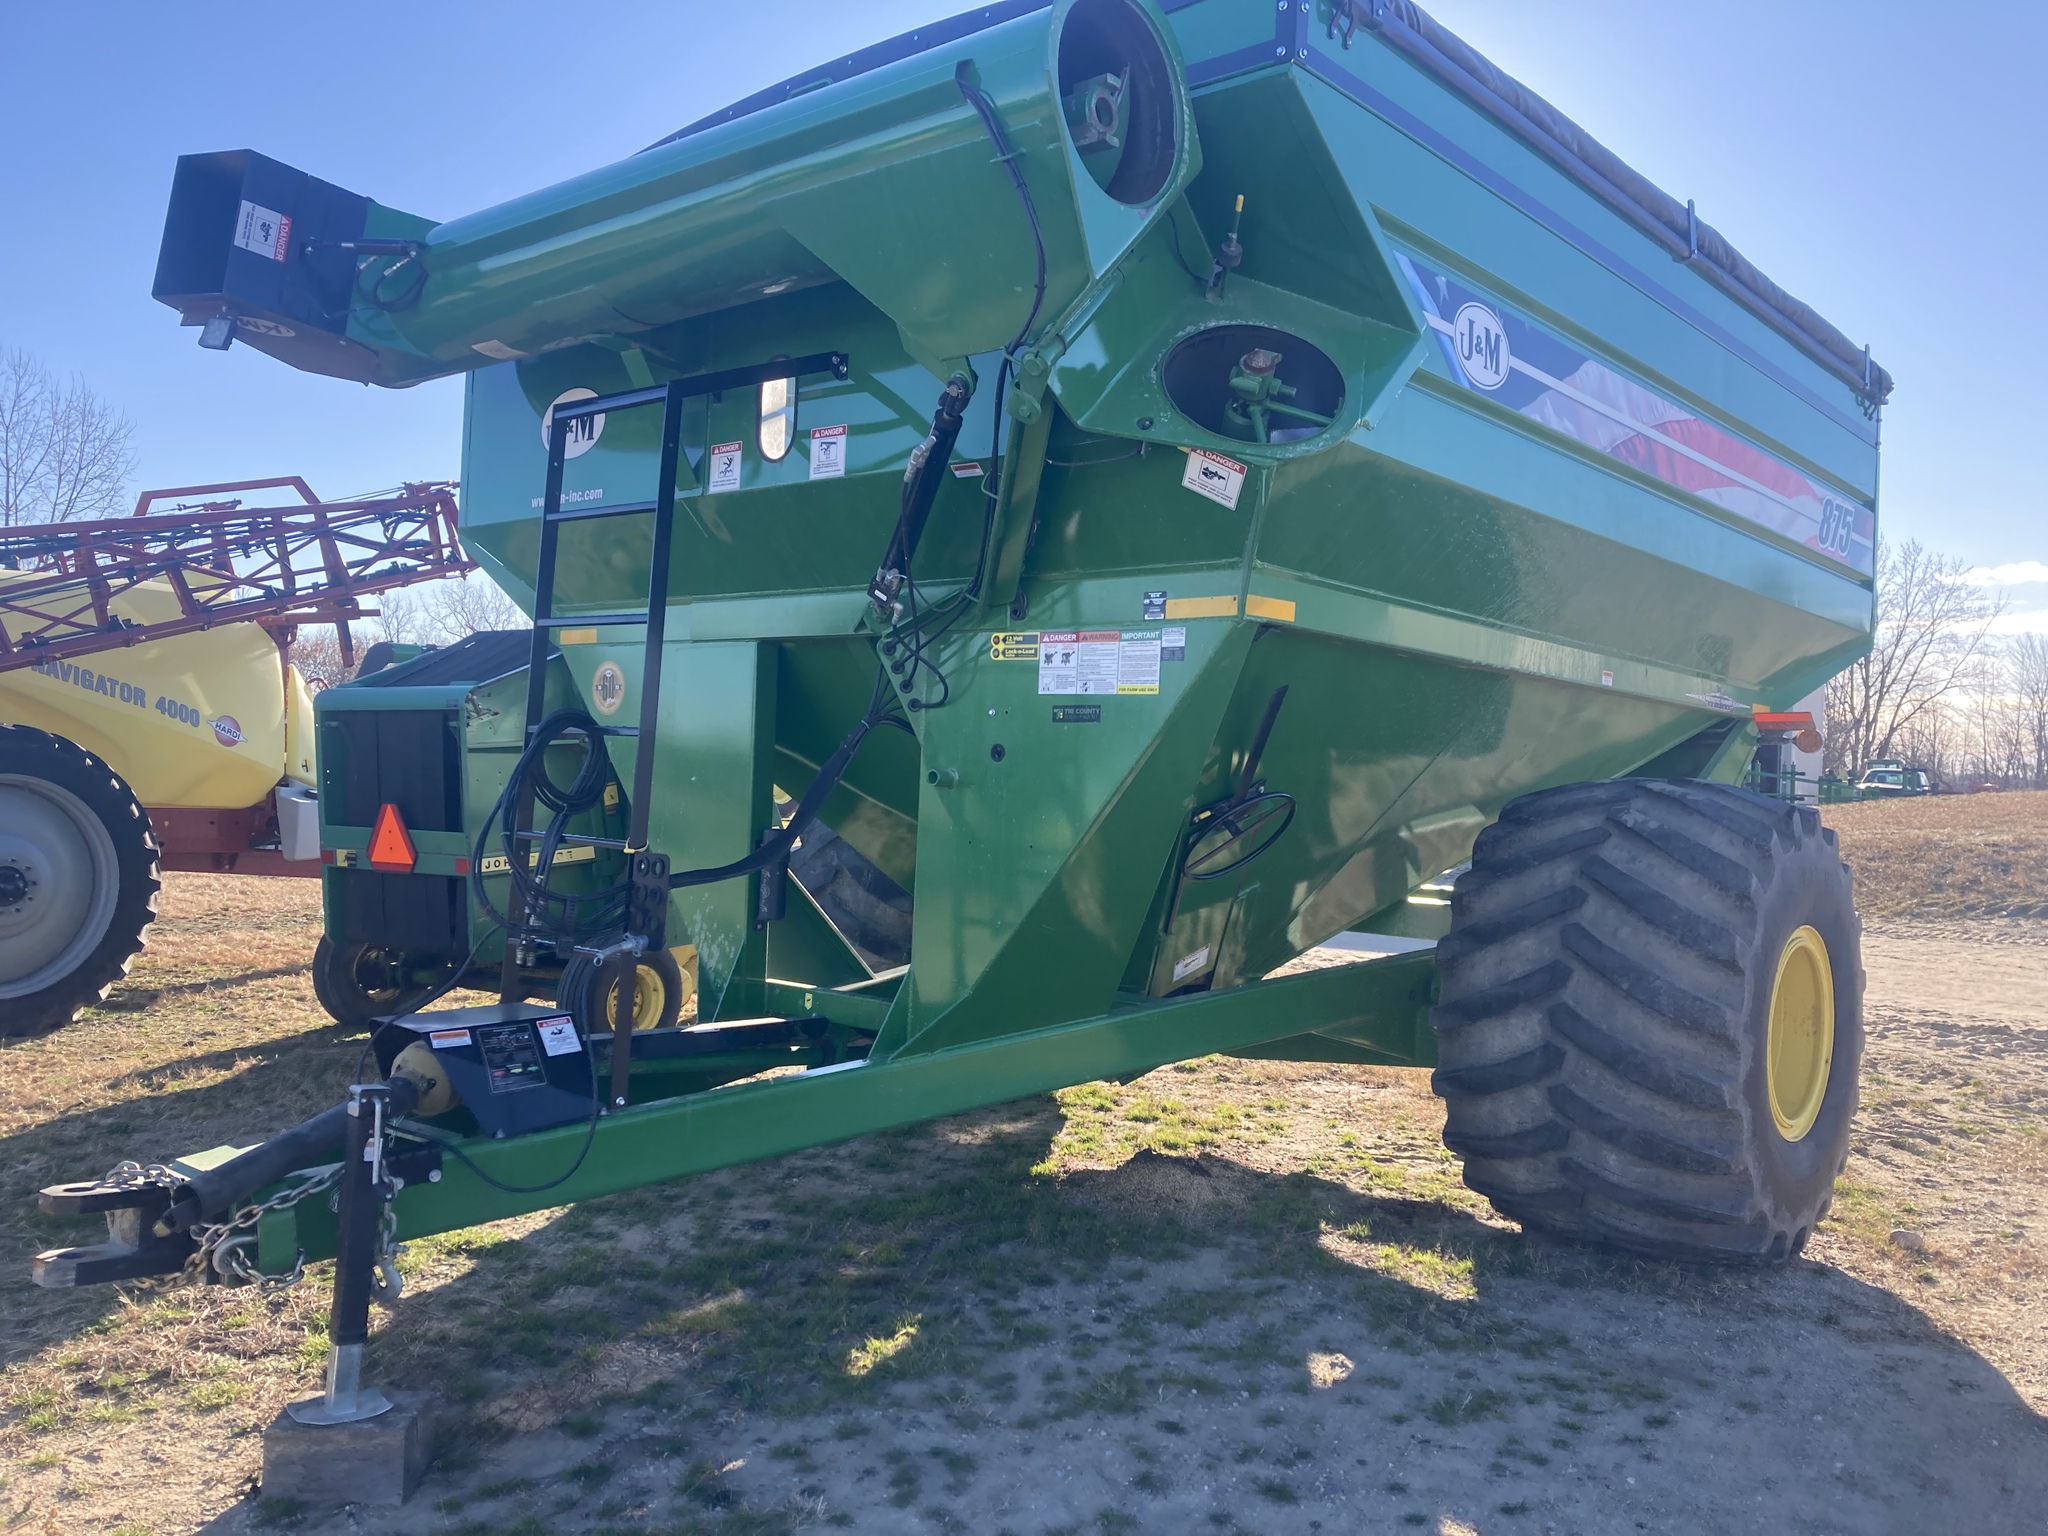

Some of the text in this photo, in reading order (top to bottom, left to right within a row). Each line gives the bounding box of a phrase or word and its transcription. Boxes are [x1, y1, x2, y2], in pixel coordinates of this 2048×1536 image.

[275, 226, 289, 261] DANGER
[1459, 317, 1502, 377] J&M
[546, 414, 595, 444] &M
[820, 426, 844, 437] DANGER
[719, 443, 740, 453] DANGER
[1205, 450, 1241, 472] DANGER
[1818, 496, 1855, 557] 875
[1049, 634, 1077, 642] DANGER
[1088, 632, 1119, 641] WARNING
[1121, 631, 1159, 640] IMPORTANT
[155, 696, 200, 728] 4000
[1075, 707, 1100, 715] COUNTY
[215, 722, 241, 740] HARDI
